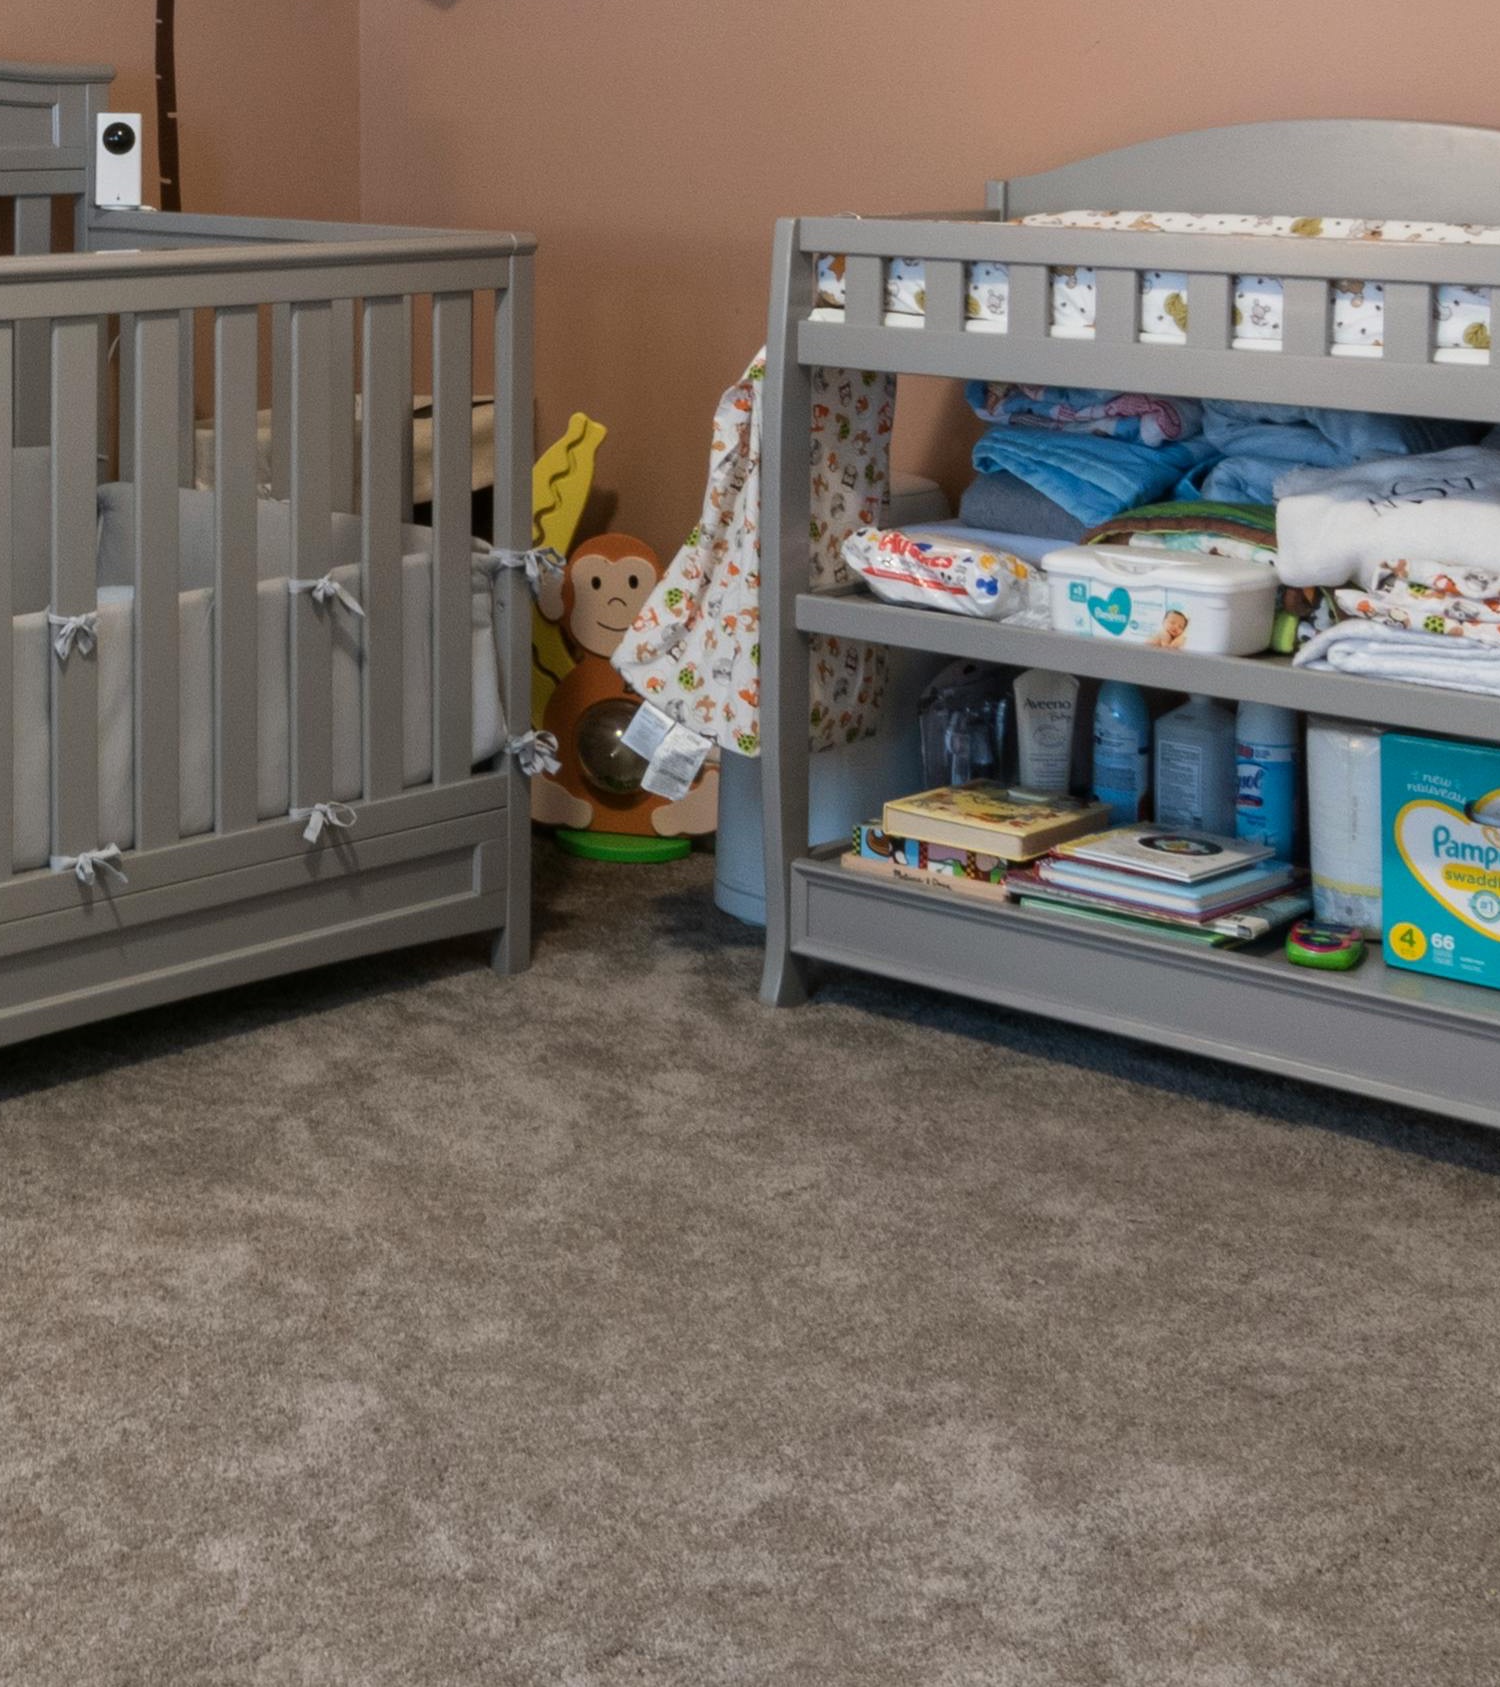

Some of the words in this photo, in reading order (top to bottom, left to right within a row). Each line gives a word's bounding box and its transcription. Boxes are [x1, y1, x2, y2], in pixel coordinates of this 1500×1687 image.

[1023, 698, 1072, 711] Aveeno
[1479, 899, 1495, 913] #1
[1400, 928, 1416, 948] 4
[1431, 932, 1456, 951] 66
